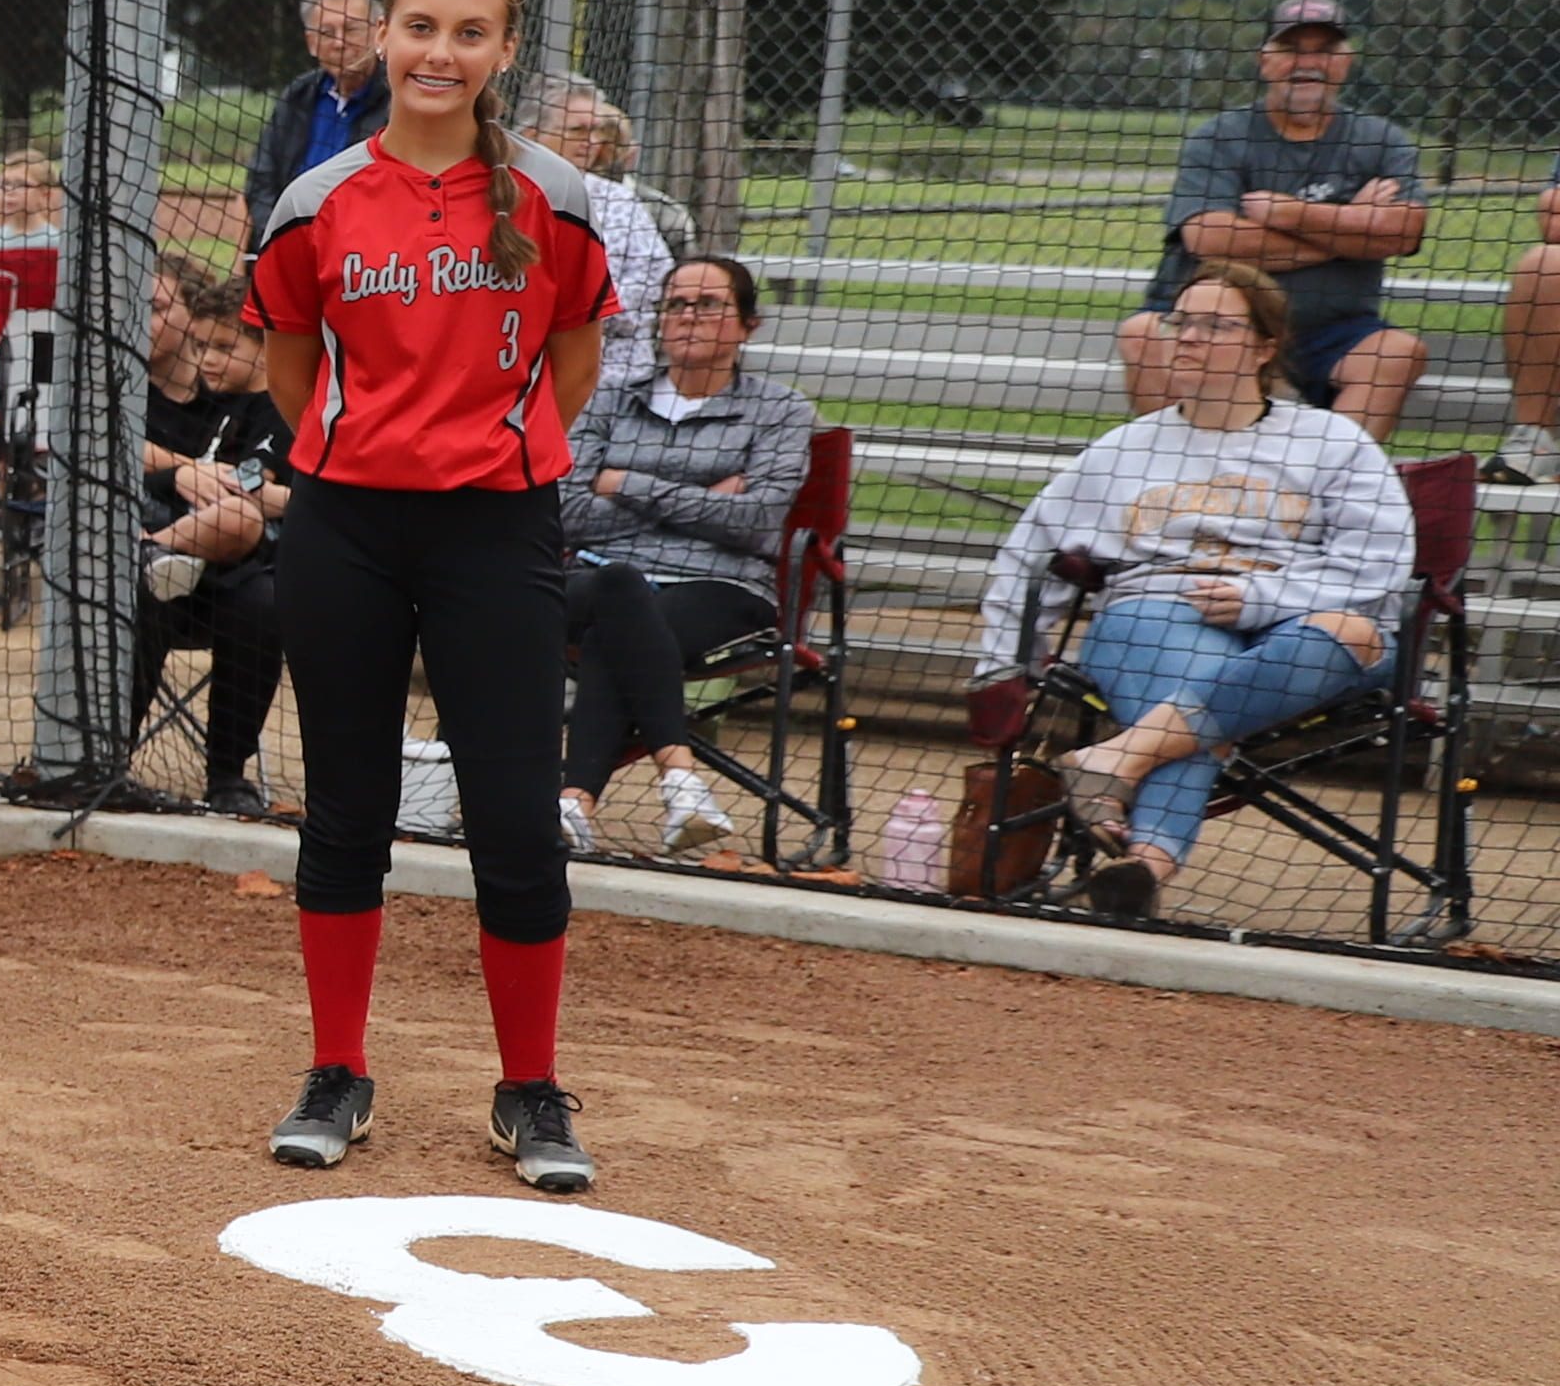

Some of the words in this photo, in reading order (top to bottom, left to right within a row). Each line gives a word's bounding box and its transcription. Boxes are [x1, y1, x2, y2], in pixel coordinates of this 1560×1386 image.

[341, 252, 418, 305] Lady
[427, 245, 528, 296] Rebes
[498, 309, 521, 370] 3
